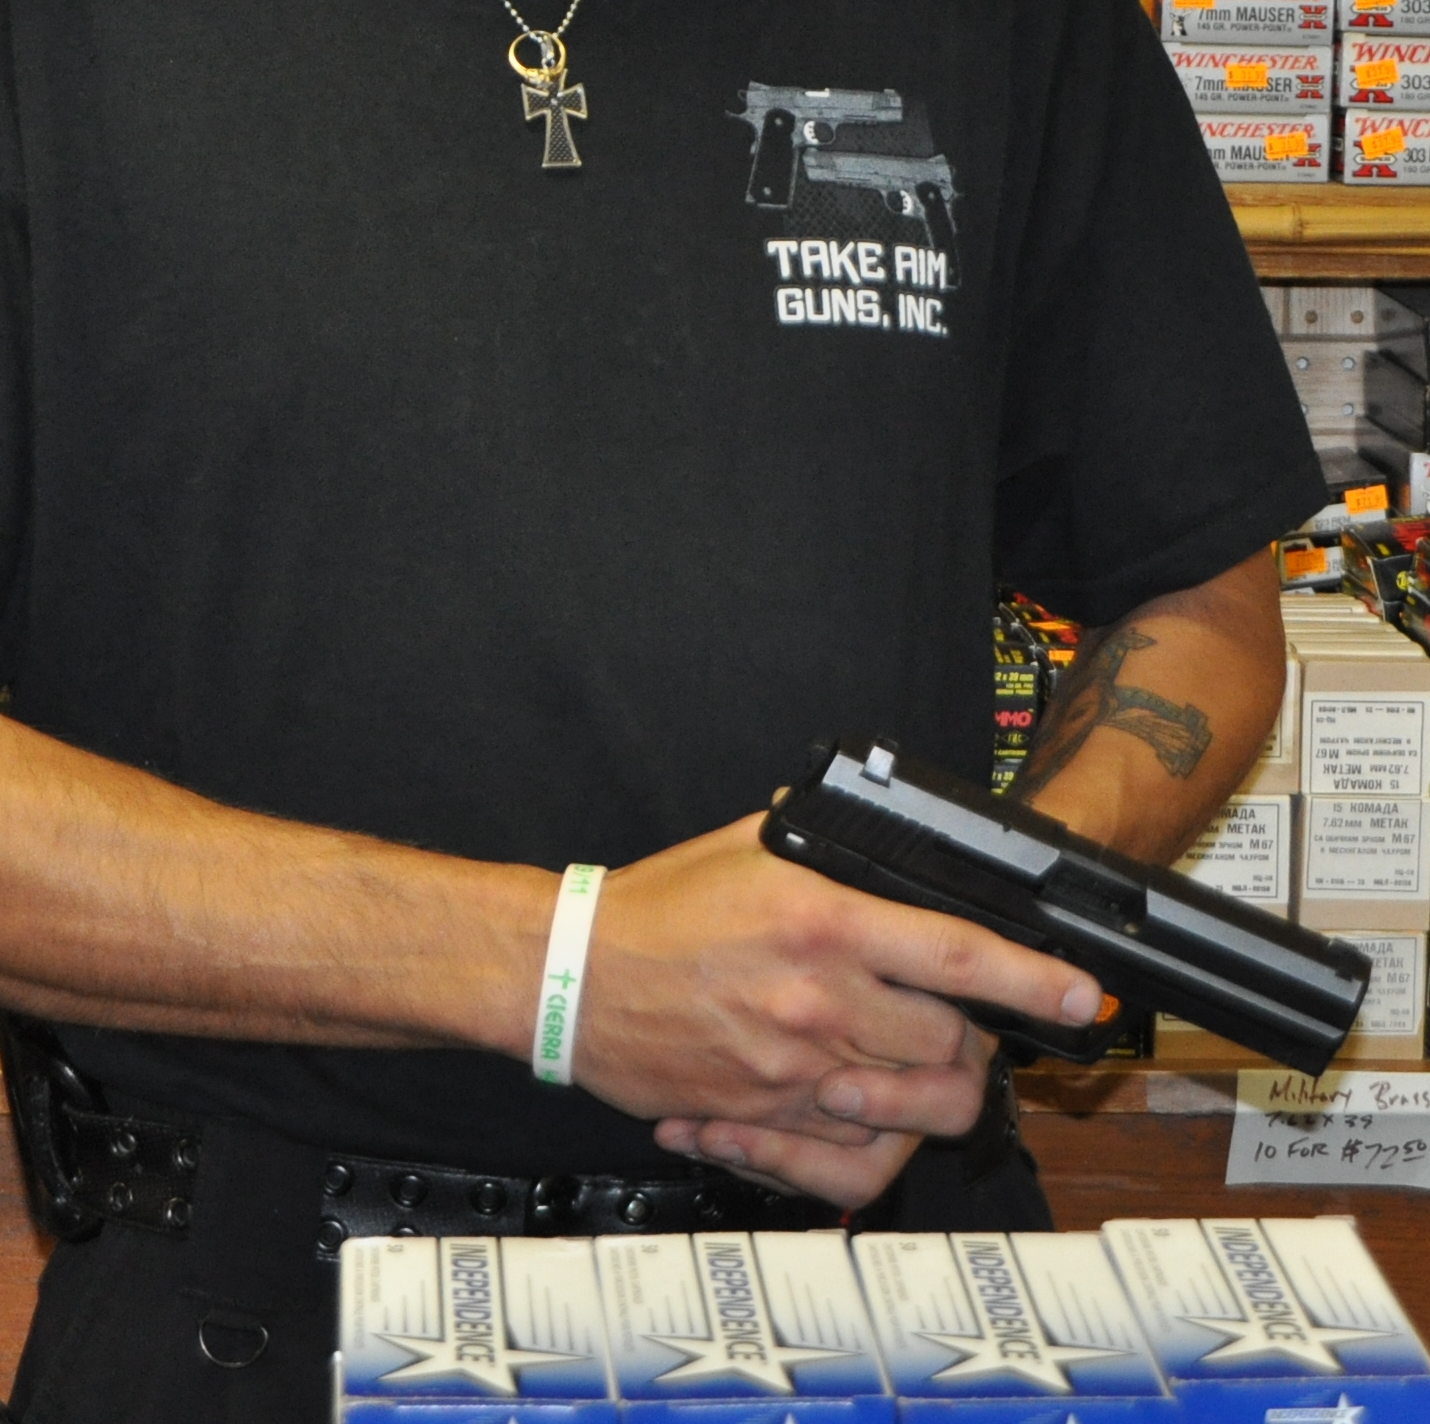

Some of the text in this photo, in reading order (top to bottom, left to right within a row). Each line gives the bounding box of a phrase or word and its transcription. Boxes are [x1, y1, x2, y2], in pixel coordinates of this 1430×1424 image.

[1403, 147, 1426, 164] 303
[766, 239, 948, 293] TAKE AIM
[775, 286, 950, 336] GUNS, INC.
[1349, 802, 1400, 814] КОМАДА
[1369, 817, 1409, 829] МЕТАК
[540, 993, 569, 1061] CIERRA
[1269, 1075, 1430, 1113] Military Brass
[1254, 1140, 1277, 1162] 10
[1287, 1137, 1329, 1159] FOR
[442, 1236, 496, 1367] INDEPENDENCE
[960, 1238, 1040, 1368] INDEPENDENCE
[1214, 1224, 1308, 1347] INDEPENDENCE
